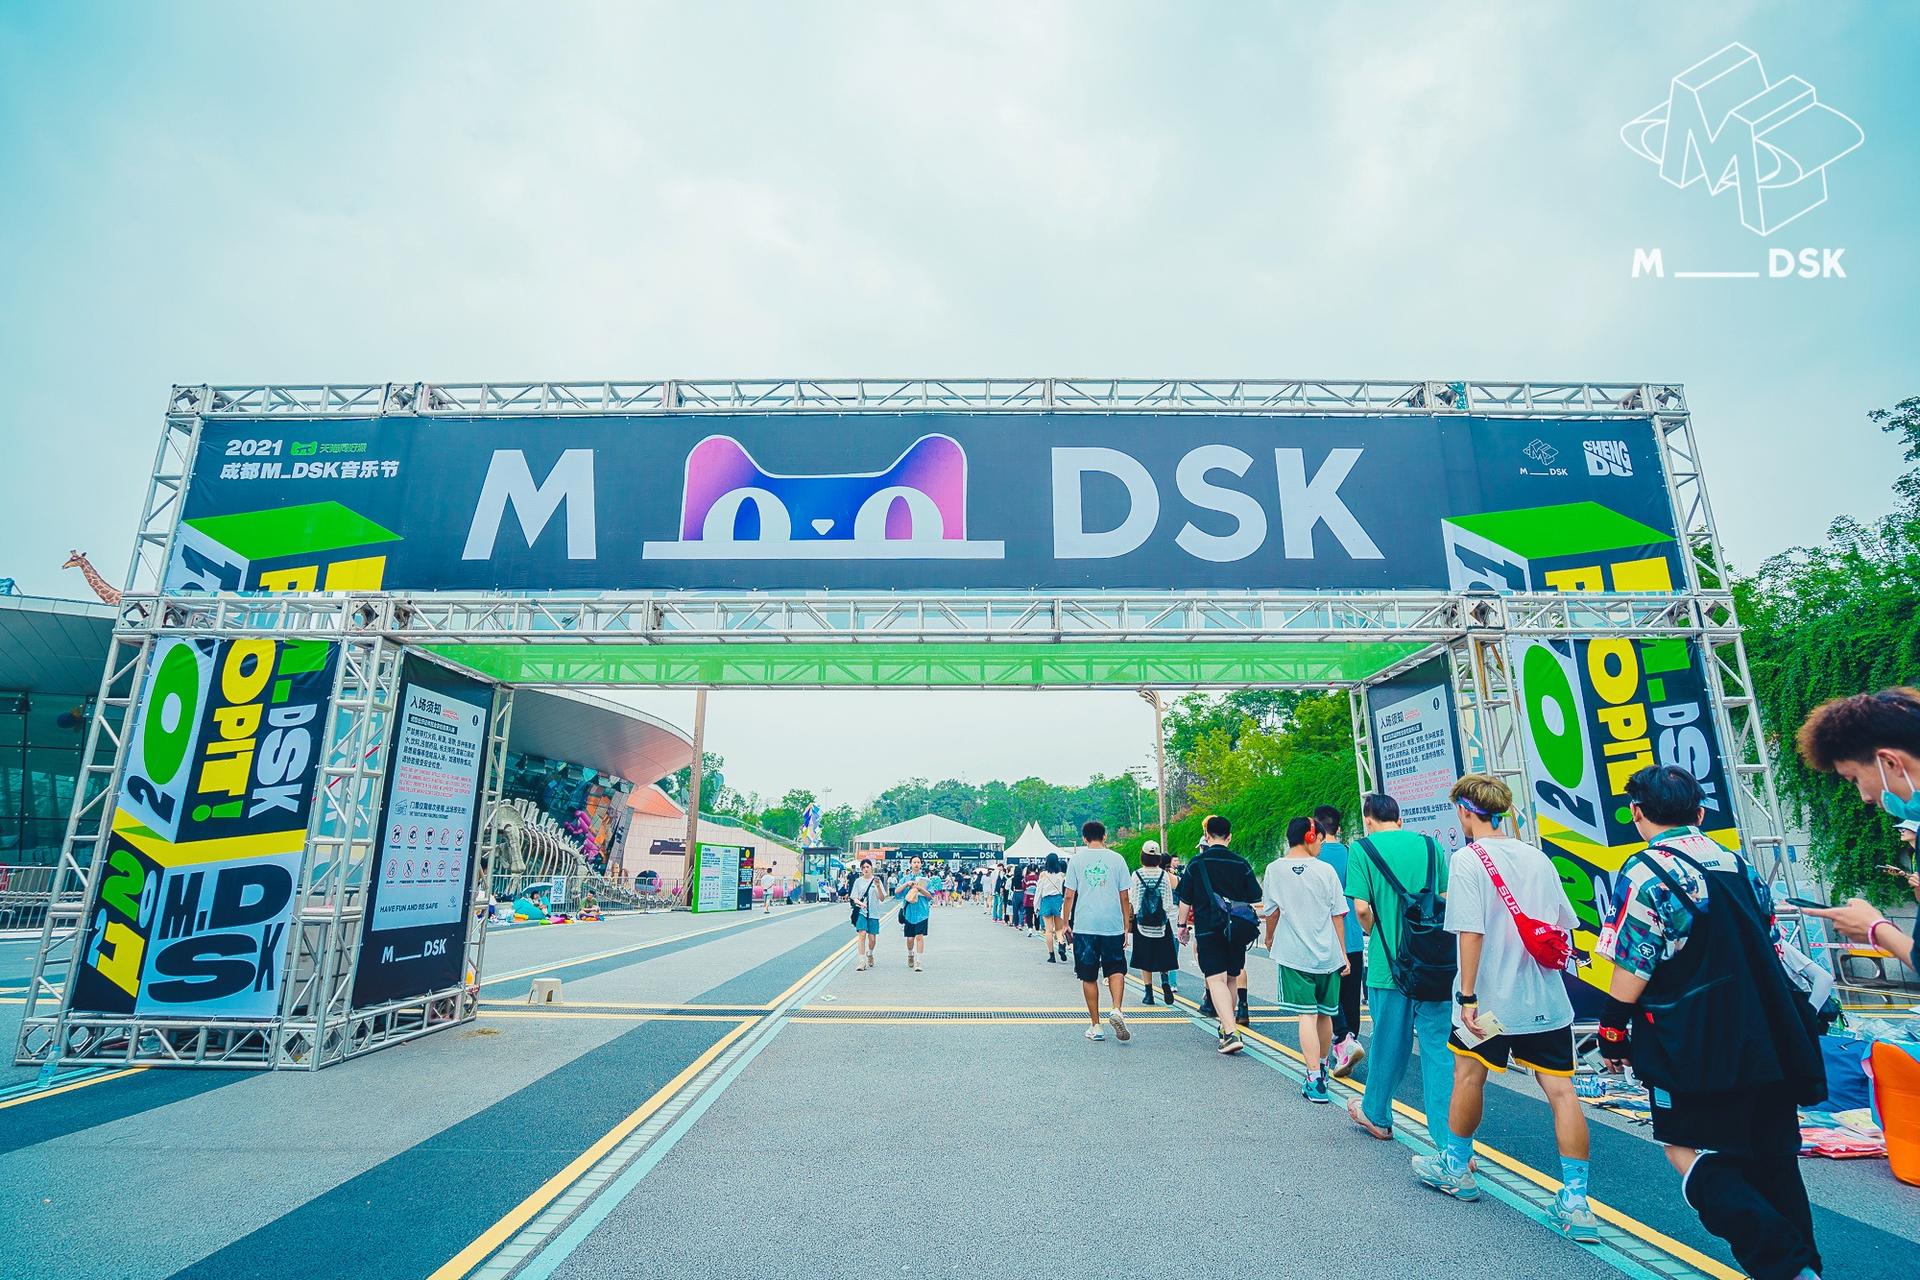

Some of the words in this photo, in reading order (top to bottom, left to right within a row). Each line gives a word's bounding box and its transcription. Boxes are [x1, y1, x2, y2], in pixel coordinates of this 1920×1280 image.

[225, 439, 283, 456] 2021
[1050, 444, 1386, 561] DSK
[380, 905, 395, 913] HAVE
